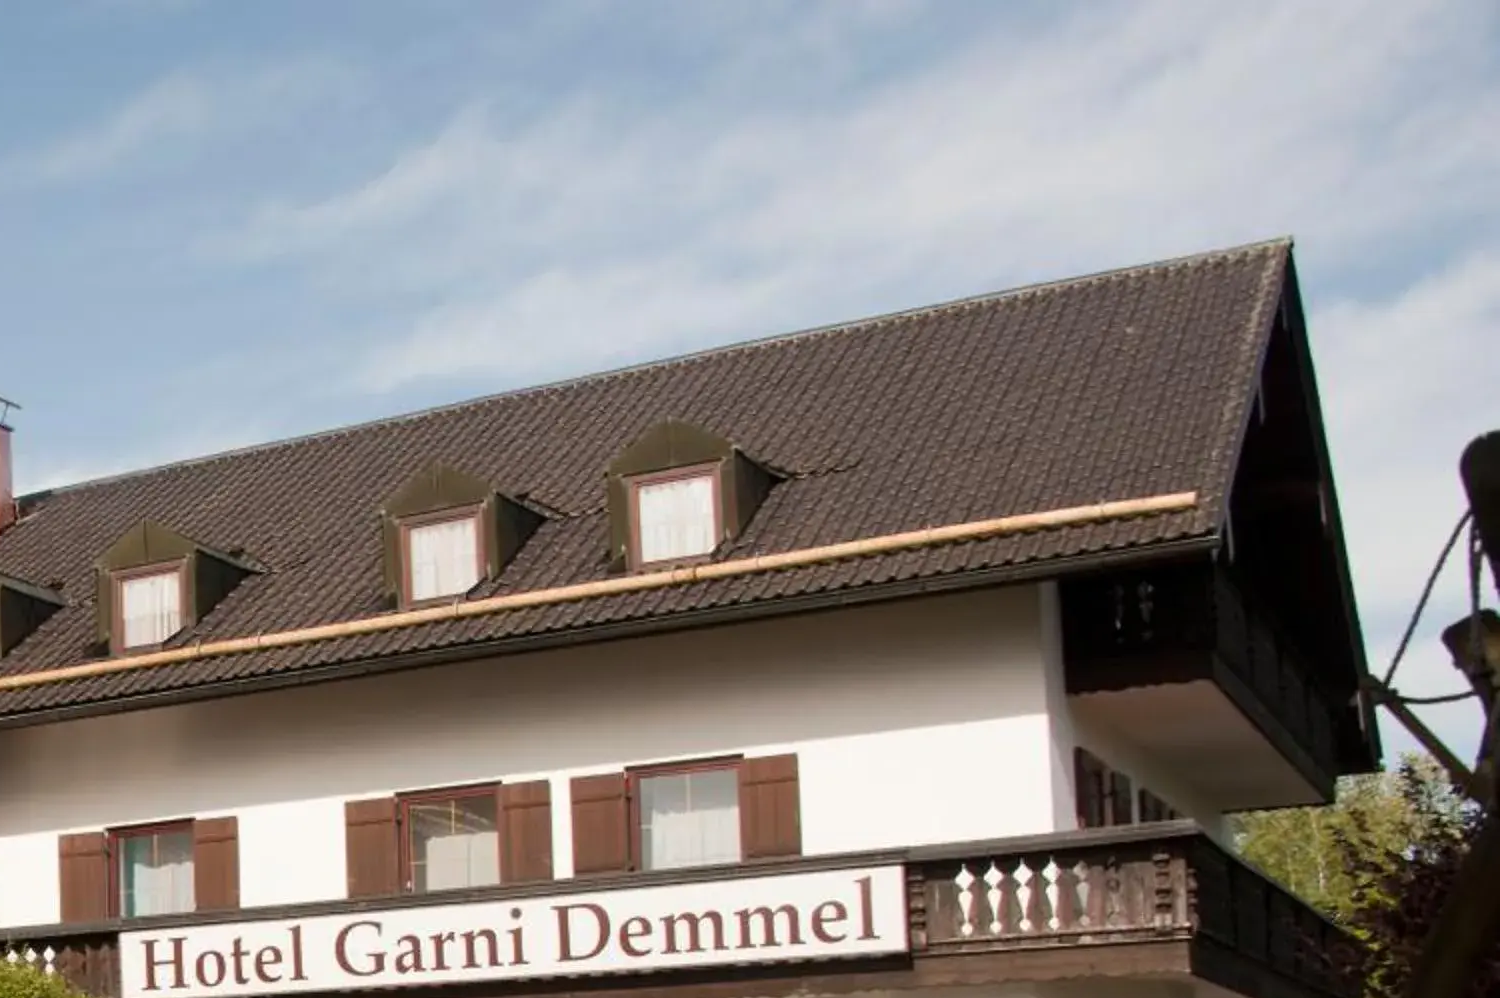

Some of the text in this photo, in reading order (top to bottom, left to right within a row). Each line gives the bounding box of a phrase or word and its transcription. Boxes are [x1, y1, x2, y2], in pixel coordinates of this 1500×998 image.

[140, 876, 882, 991] Hotel Garni Demmel
